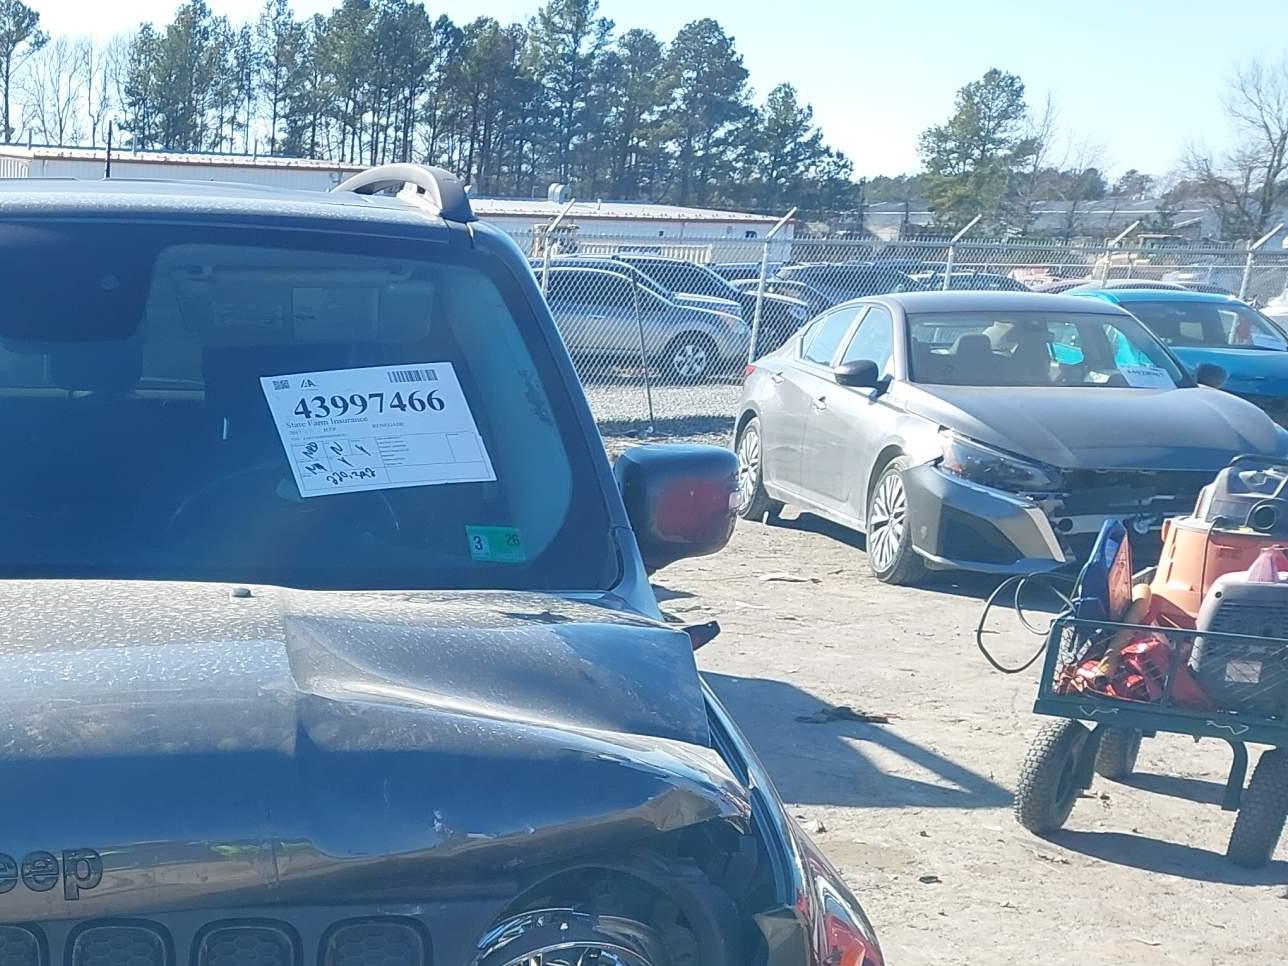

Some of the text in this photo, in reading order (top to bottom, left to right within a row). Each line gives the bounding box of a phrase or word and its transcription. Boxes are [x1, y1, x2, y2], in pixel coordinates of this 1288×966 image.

[294, 389, 446, 419] 43997466
[285, 416, 369, 429] State Farm Insurance
[473, 534, 520, 550] 3 26
